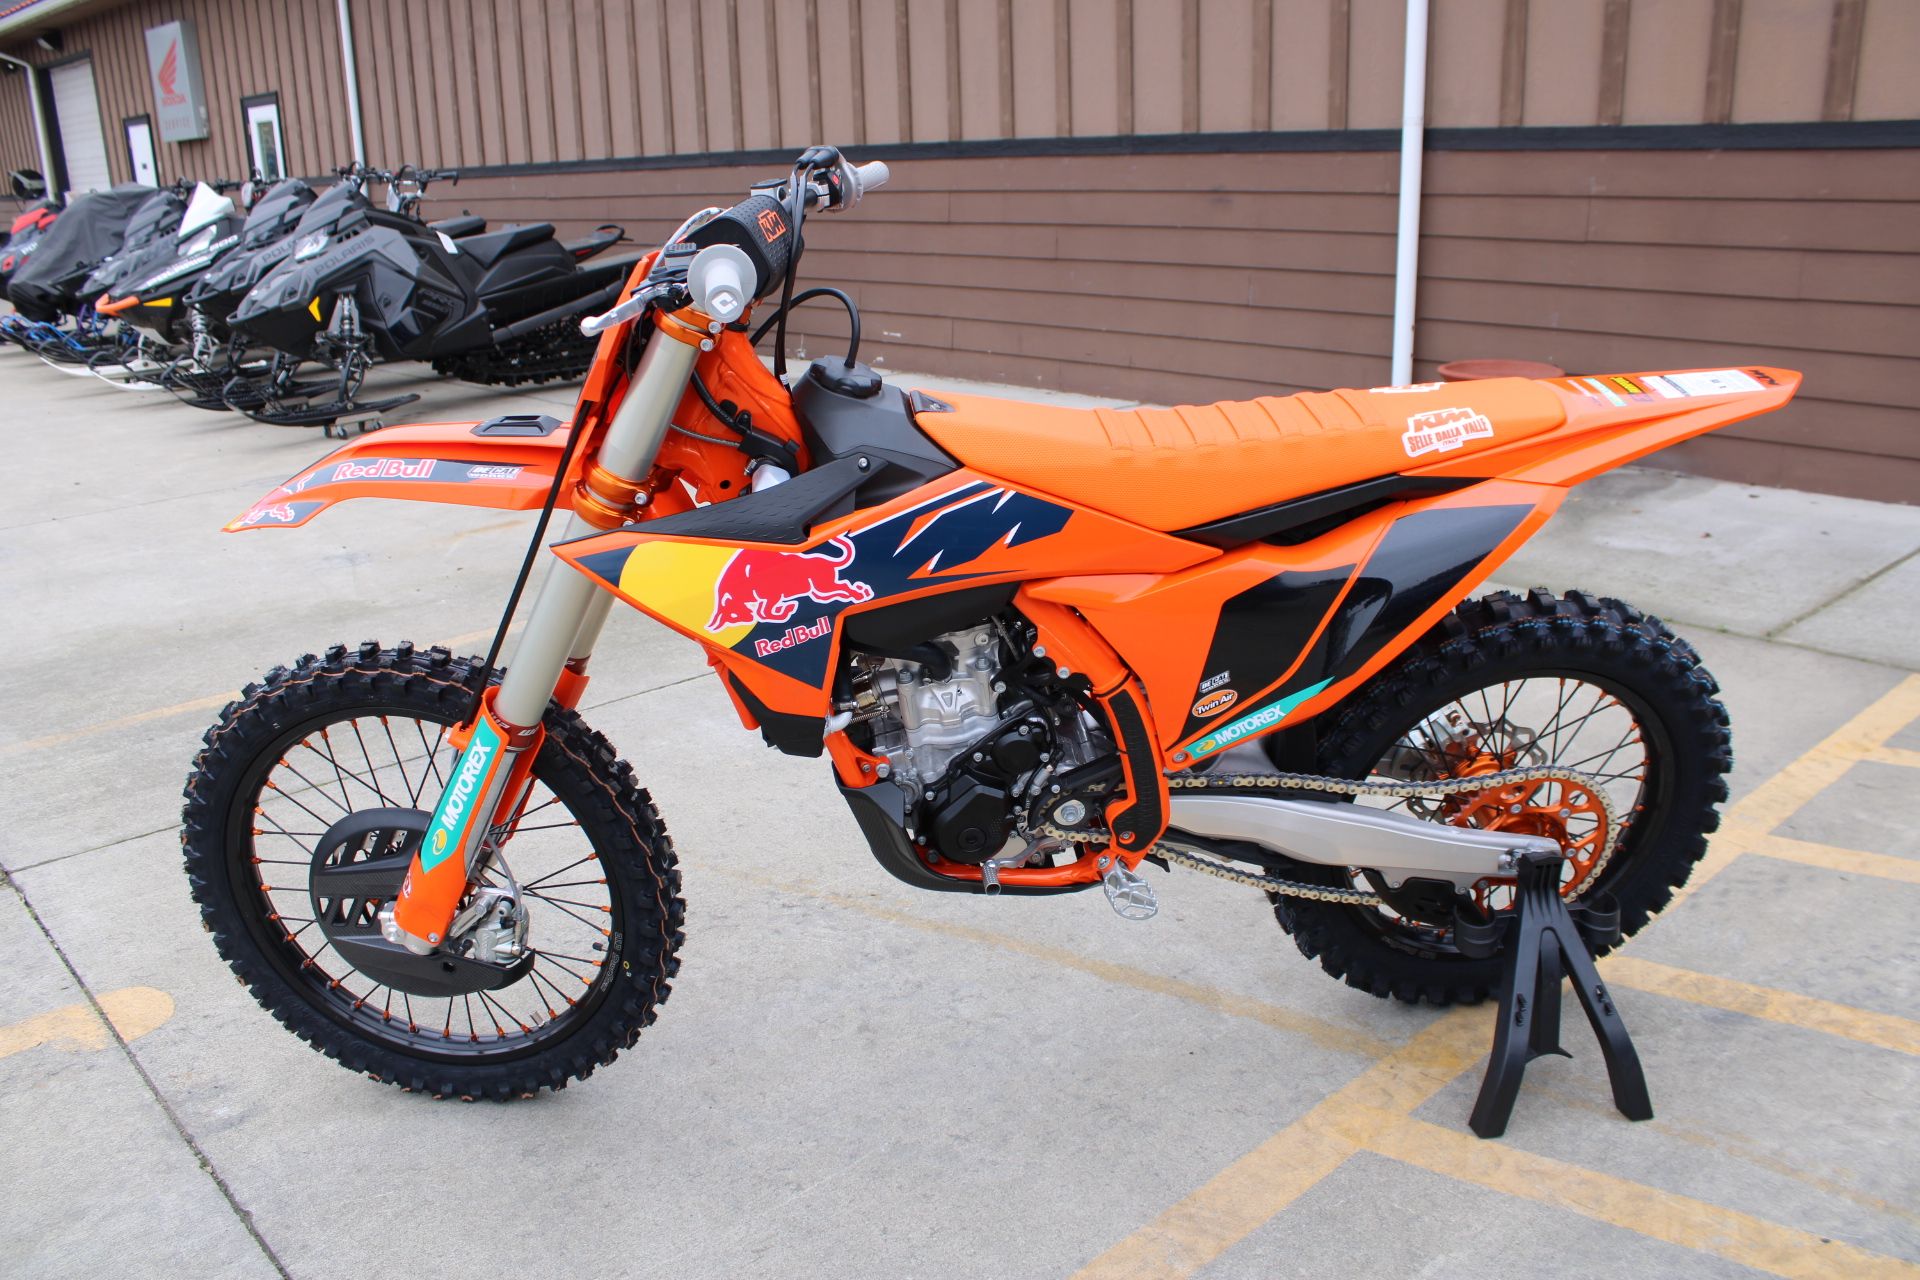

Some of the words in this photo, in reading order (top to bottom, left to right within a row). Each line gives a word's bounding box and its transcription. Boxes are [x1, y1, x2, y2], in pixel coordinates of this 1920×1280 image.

[314, 233, 375, 274] POLARIS
[1407, 433, 1434, 453] SELLE
[1434, 426, 1463, 442] DALLA
[1462, 417, 1489, 436] VALLE
[332, 459, 387, 481] Red
[381, 459, 437, 479] Bull
[755, 628, 795, 657] Red
[794, 615, 832, 644] Bull
[1196, 699, 1219, 715] Twin
[1219, 692, 1235, 705] Air
[1214, 704, 1288, 745] MOTOREX
[441, 737, 492, 831] MOTOREX
